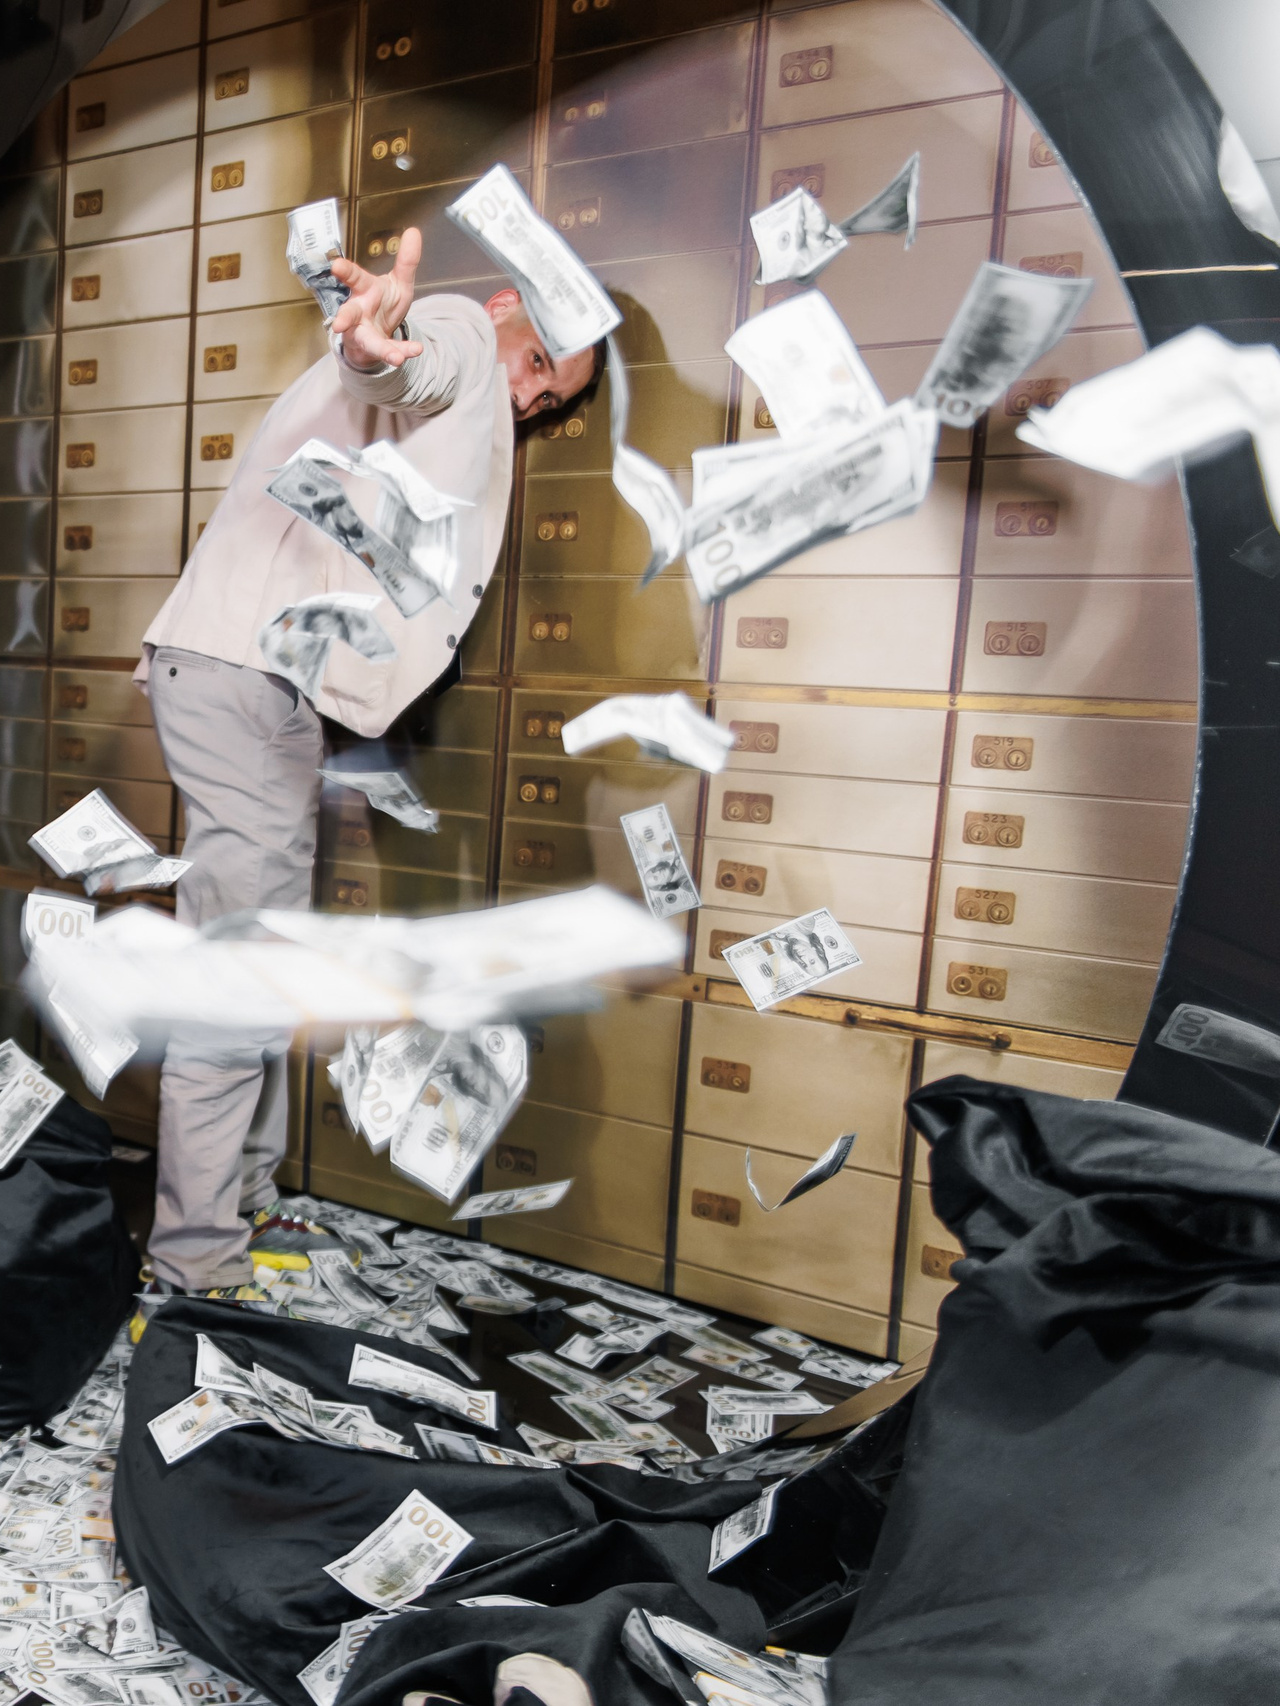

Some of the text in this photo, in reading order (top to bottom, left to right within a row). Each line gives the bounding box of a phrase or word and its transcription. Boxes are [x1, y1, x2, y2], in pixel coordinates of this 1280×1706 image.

[1038, 254, 1064, 265] 503
[705, 539, 742, 590] 00
[1006, 622, 1028, 632] 515
[993, 737, 1014, 747] 519
[982, 813, 1007, 823] 523
[732, 863, 754, 874] 526
[974, 889, 999, 900] 527
[38, 907, 85, 940] 100
[968, 965, 988, 975] 531
[22, 1072, 54, 1100] 100
[360, 1079, 393, 1124] 00
[317, 1254, 345, 1266] 100
[466, 1396, 487, 1421] 00
[715, 1426, 751, 1439] 100
[408, 1505, 456, 1549] 100
[55, 1527, 73, 1555] 100
[31, 1639, 56, 1669] 100
